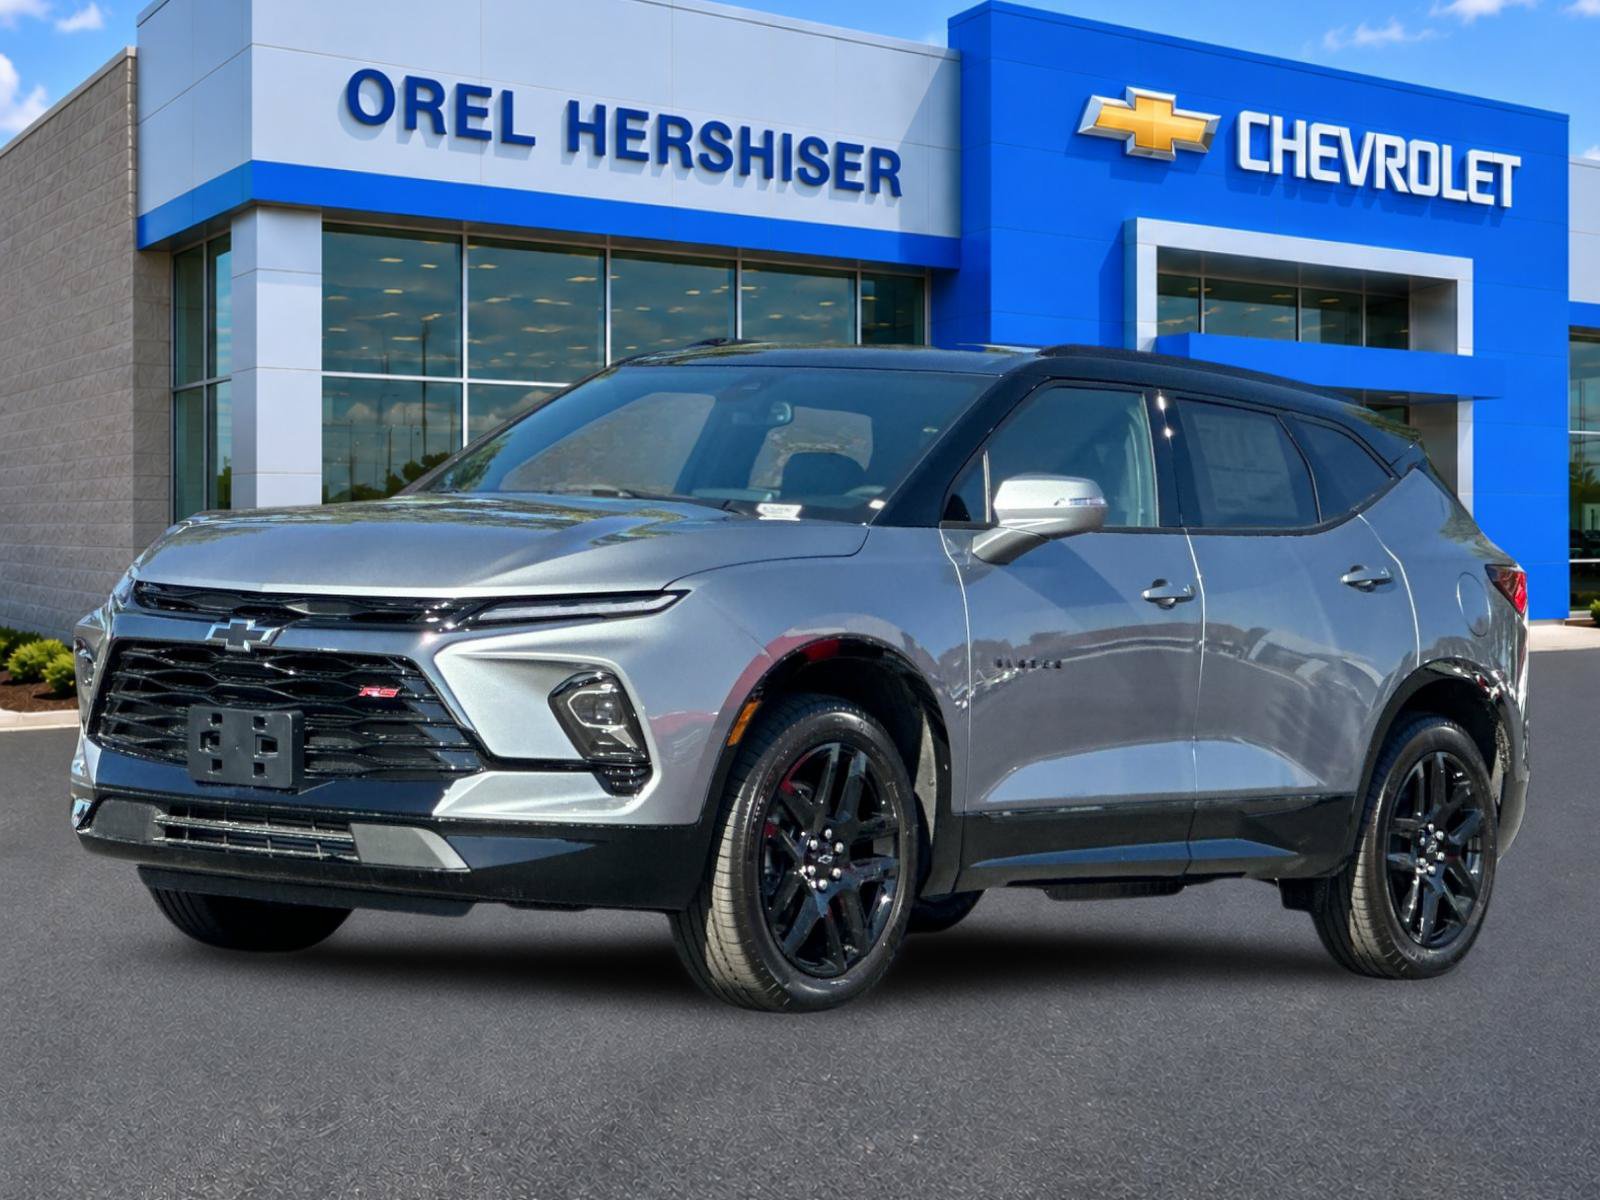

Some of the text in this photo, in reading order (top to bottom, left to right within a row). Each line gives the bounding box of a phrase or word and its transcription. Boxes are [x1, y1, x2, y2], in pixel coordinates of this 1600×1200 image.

[346, 69, 902, 197] OREL HERSHISER
[1237, 110, 1521, 208] CHEVROLET
[358, 686, 399, 698] RS
